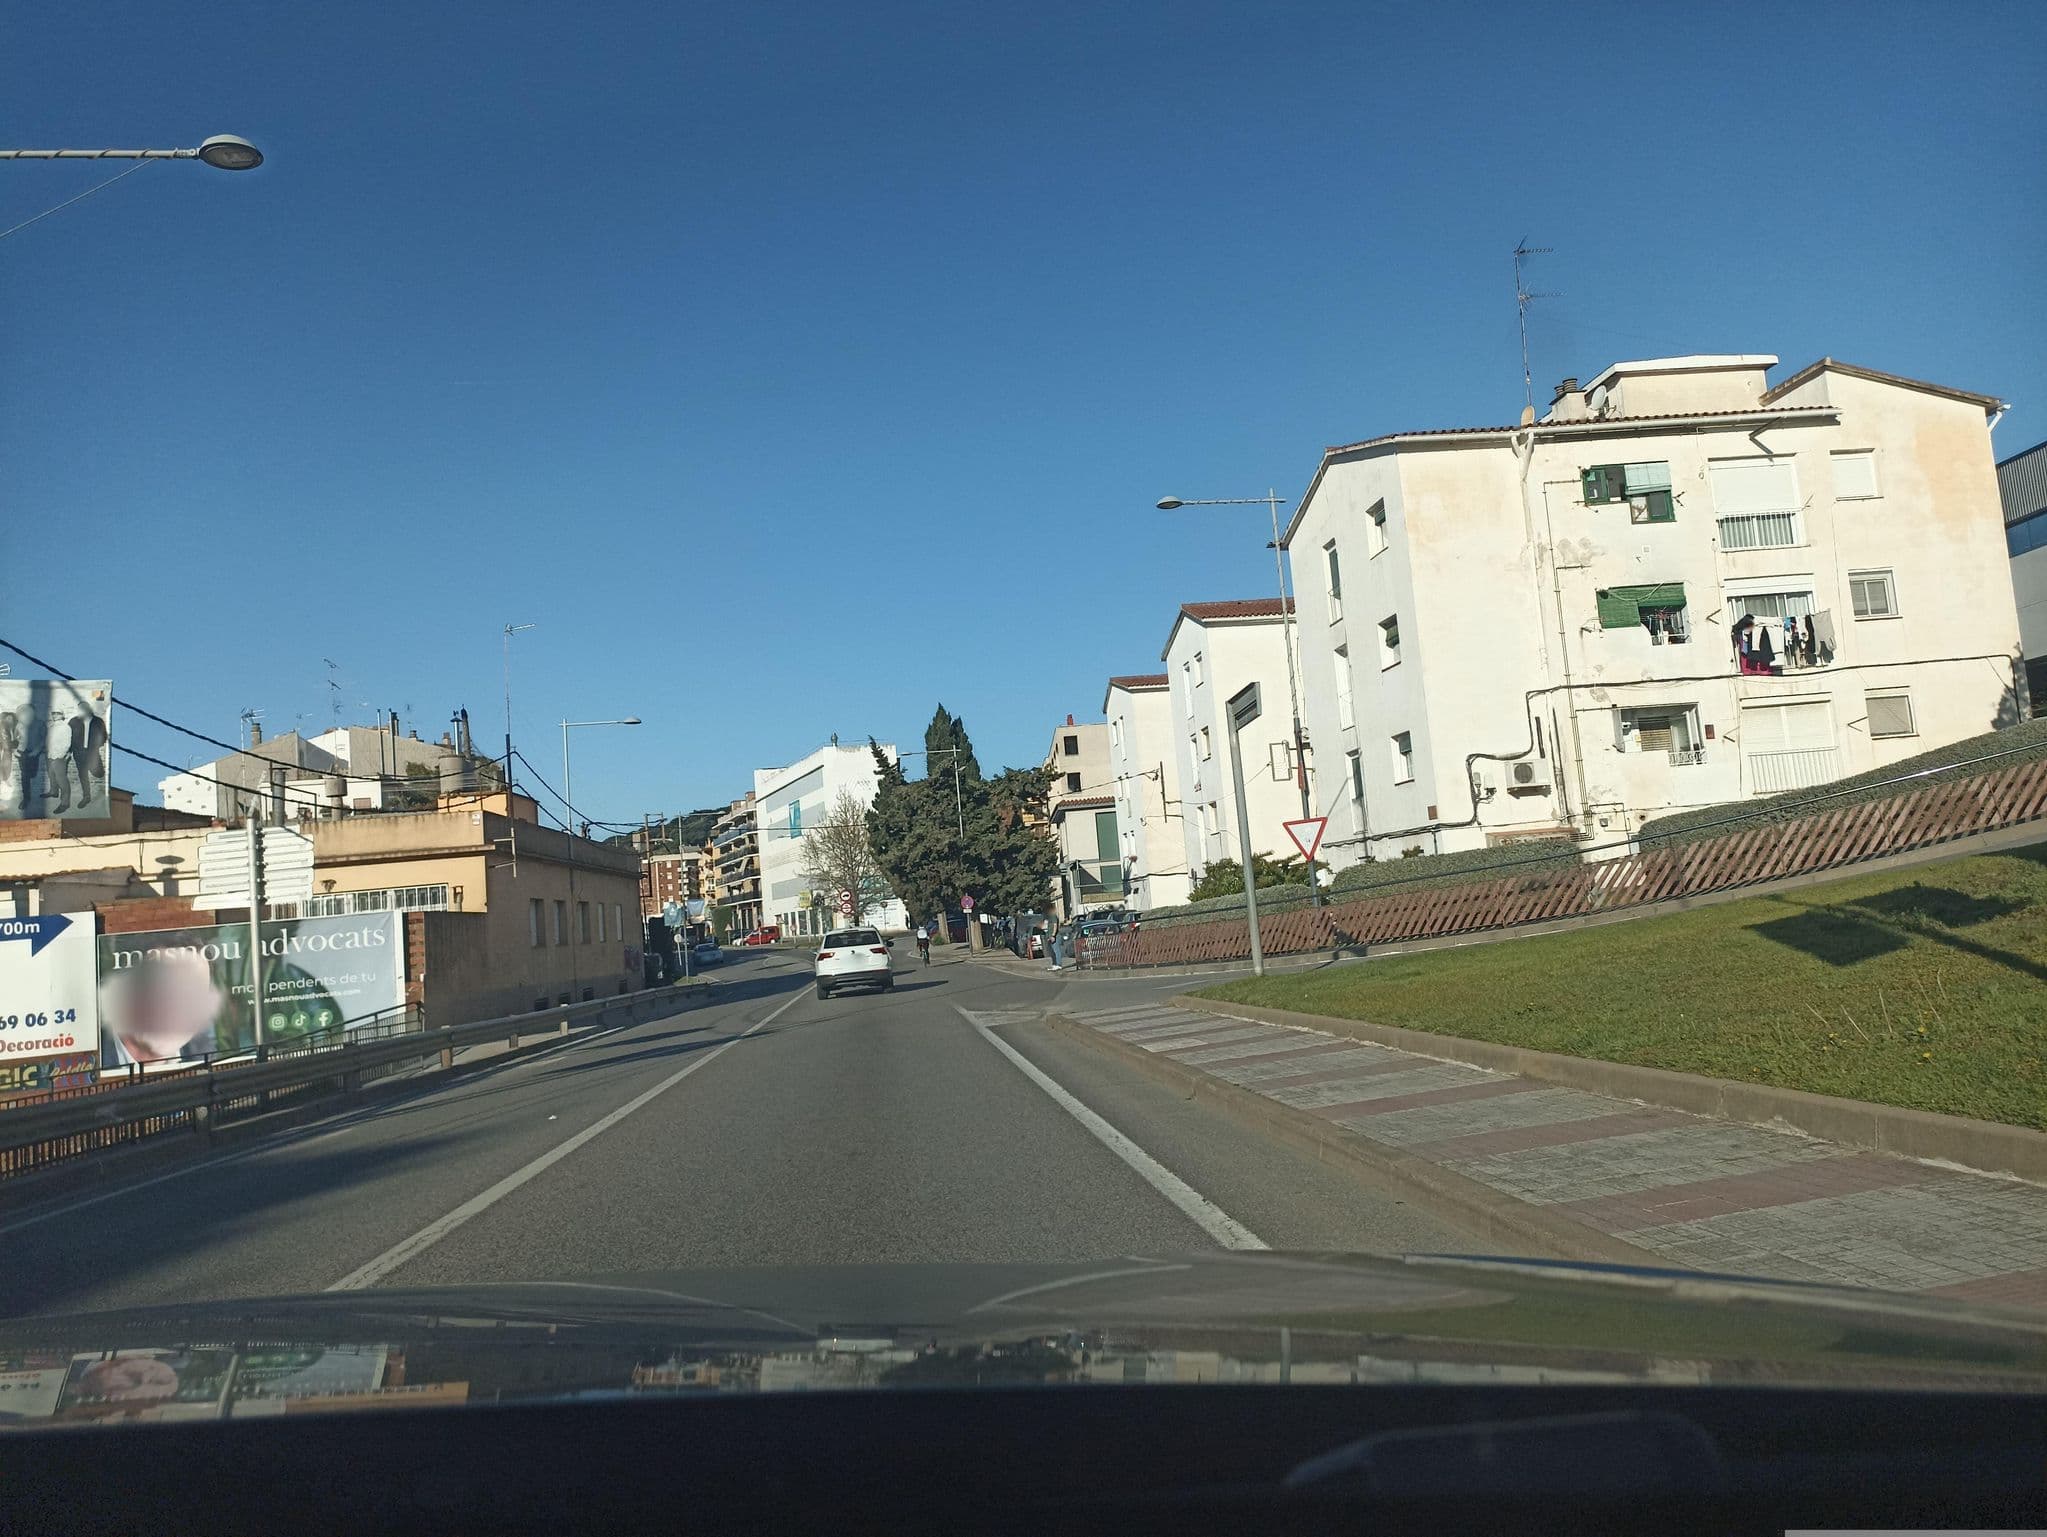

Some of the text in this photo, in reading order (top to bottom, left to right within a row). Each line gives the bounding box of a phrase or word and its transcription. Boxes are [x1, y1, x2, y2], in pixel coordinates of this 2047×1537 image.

[269, 975, 337, 993] pendents
[339, 972, 359, 984] de
[361, 972, 376, 982] tu
[25, 1012, 48, 1028] 06
[54, 1008, 77, 1024] 34
